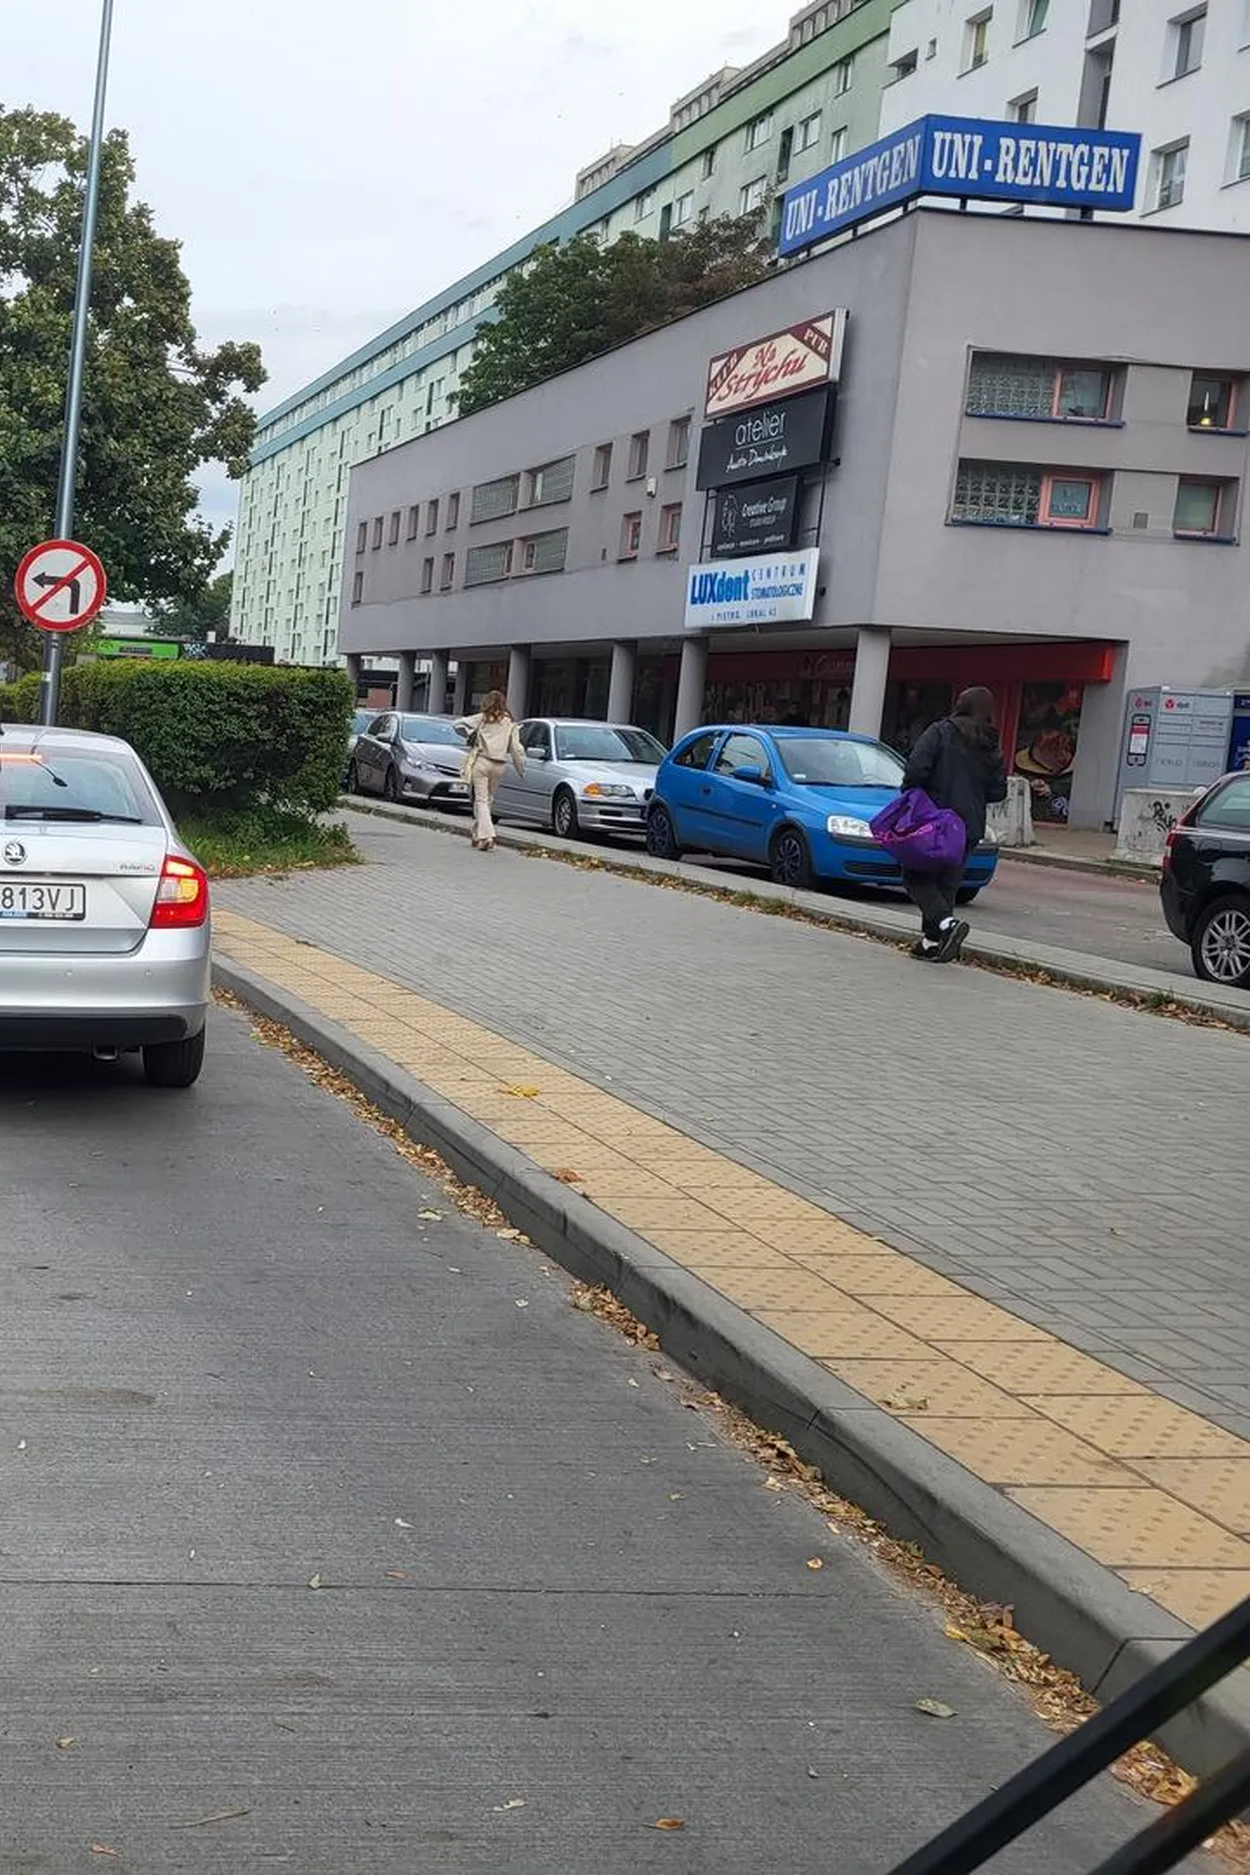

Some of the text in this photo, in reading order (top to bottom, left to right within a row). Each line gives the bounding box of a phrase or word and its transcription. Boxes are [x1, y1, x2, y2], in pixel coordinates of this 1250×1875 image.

[803, 327, 828, 354] PUB
[735, 411, 786, 446] atelier
[751, 563, 806, 582] CENTRUM
[690, 569, 750, 605] LUXdent
[1, 886, 75, 912] 813VJ
